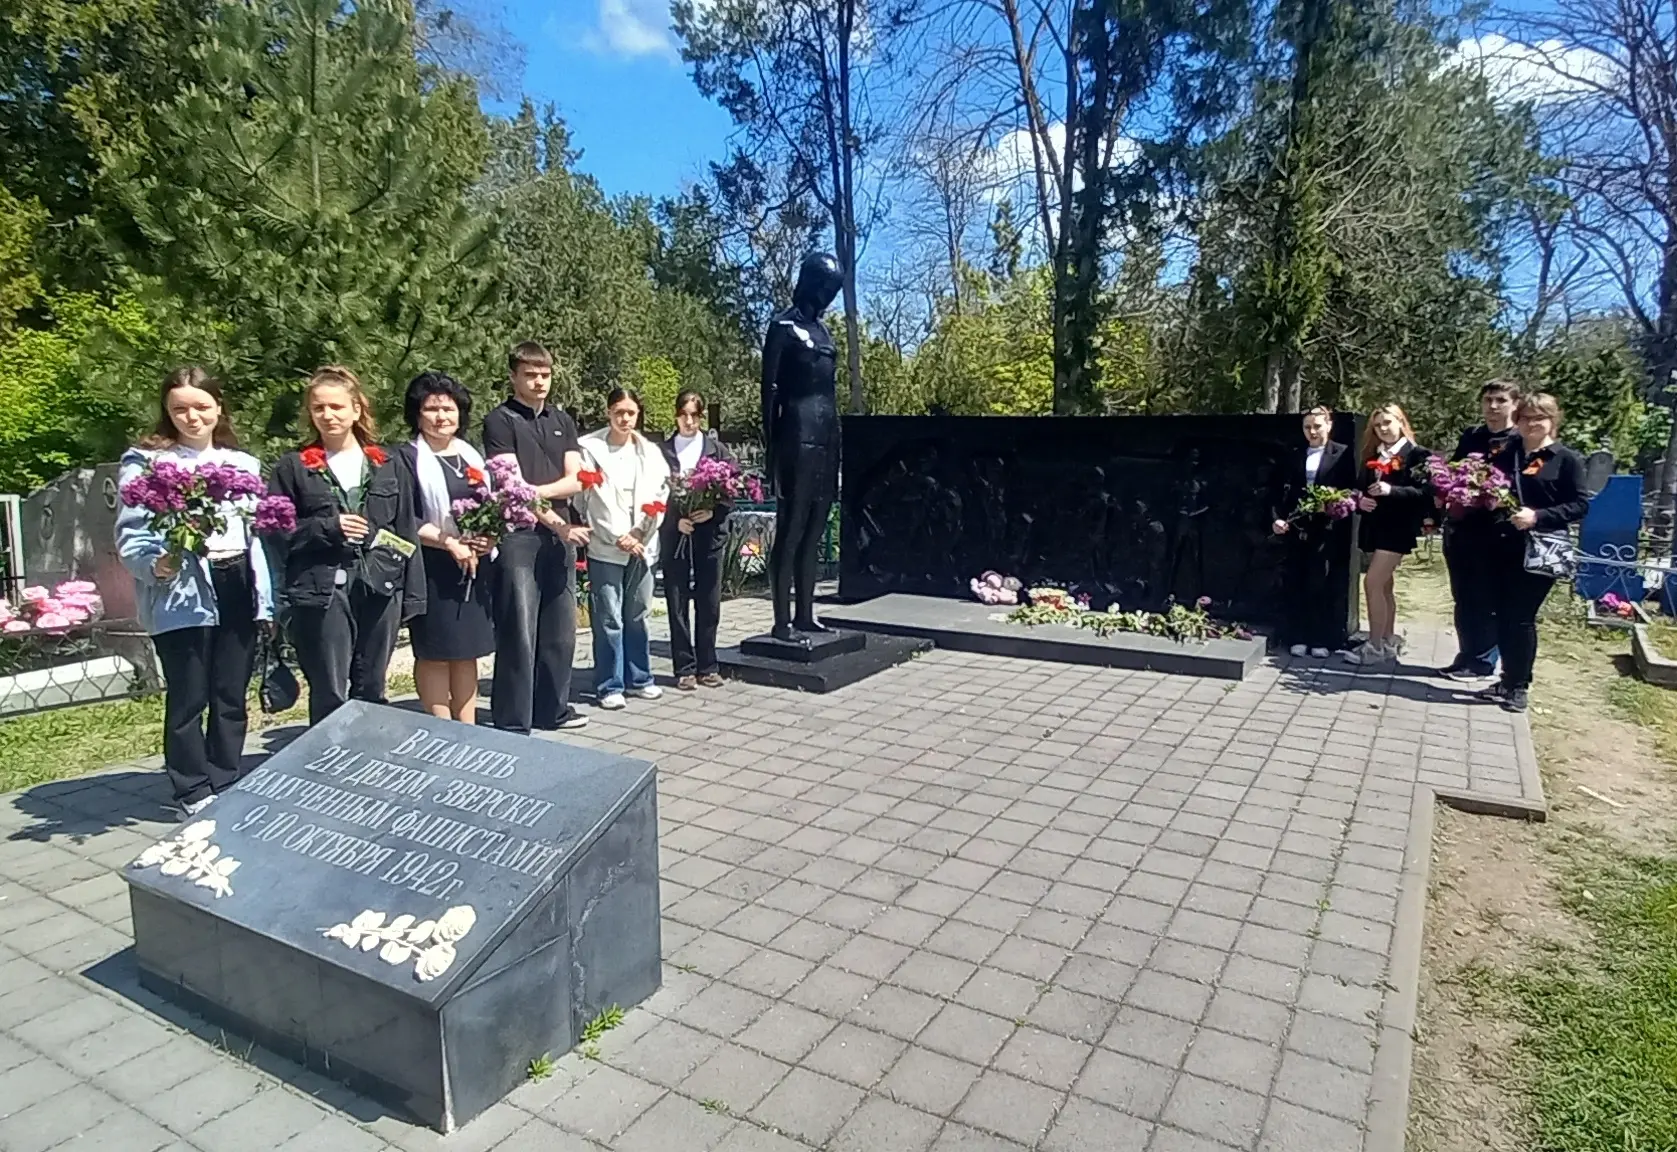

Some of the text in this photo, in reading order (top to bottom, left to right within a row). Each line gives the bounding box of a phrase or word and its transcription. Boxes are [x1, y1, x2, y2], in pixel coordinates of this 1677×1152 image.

[304, 745, 555, 828] 214 ДЕТЯМ, ЗВЕРСКИ
[390, 728, 520, 779] В ПАМЯТЬ
[237, 768, 402, 830] ЗАМУЧЕННЫМ
[231, 804, 299, 842] 9-10
[282, 823, 396, 875] ОКТЯБРЯ
